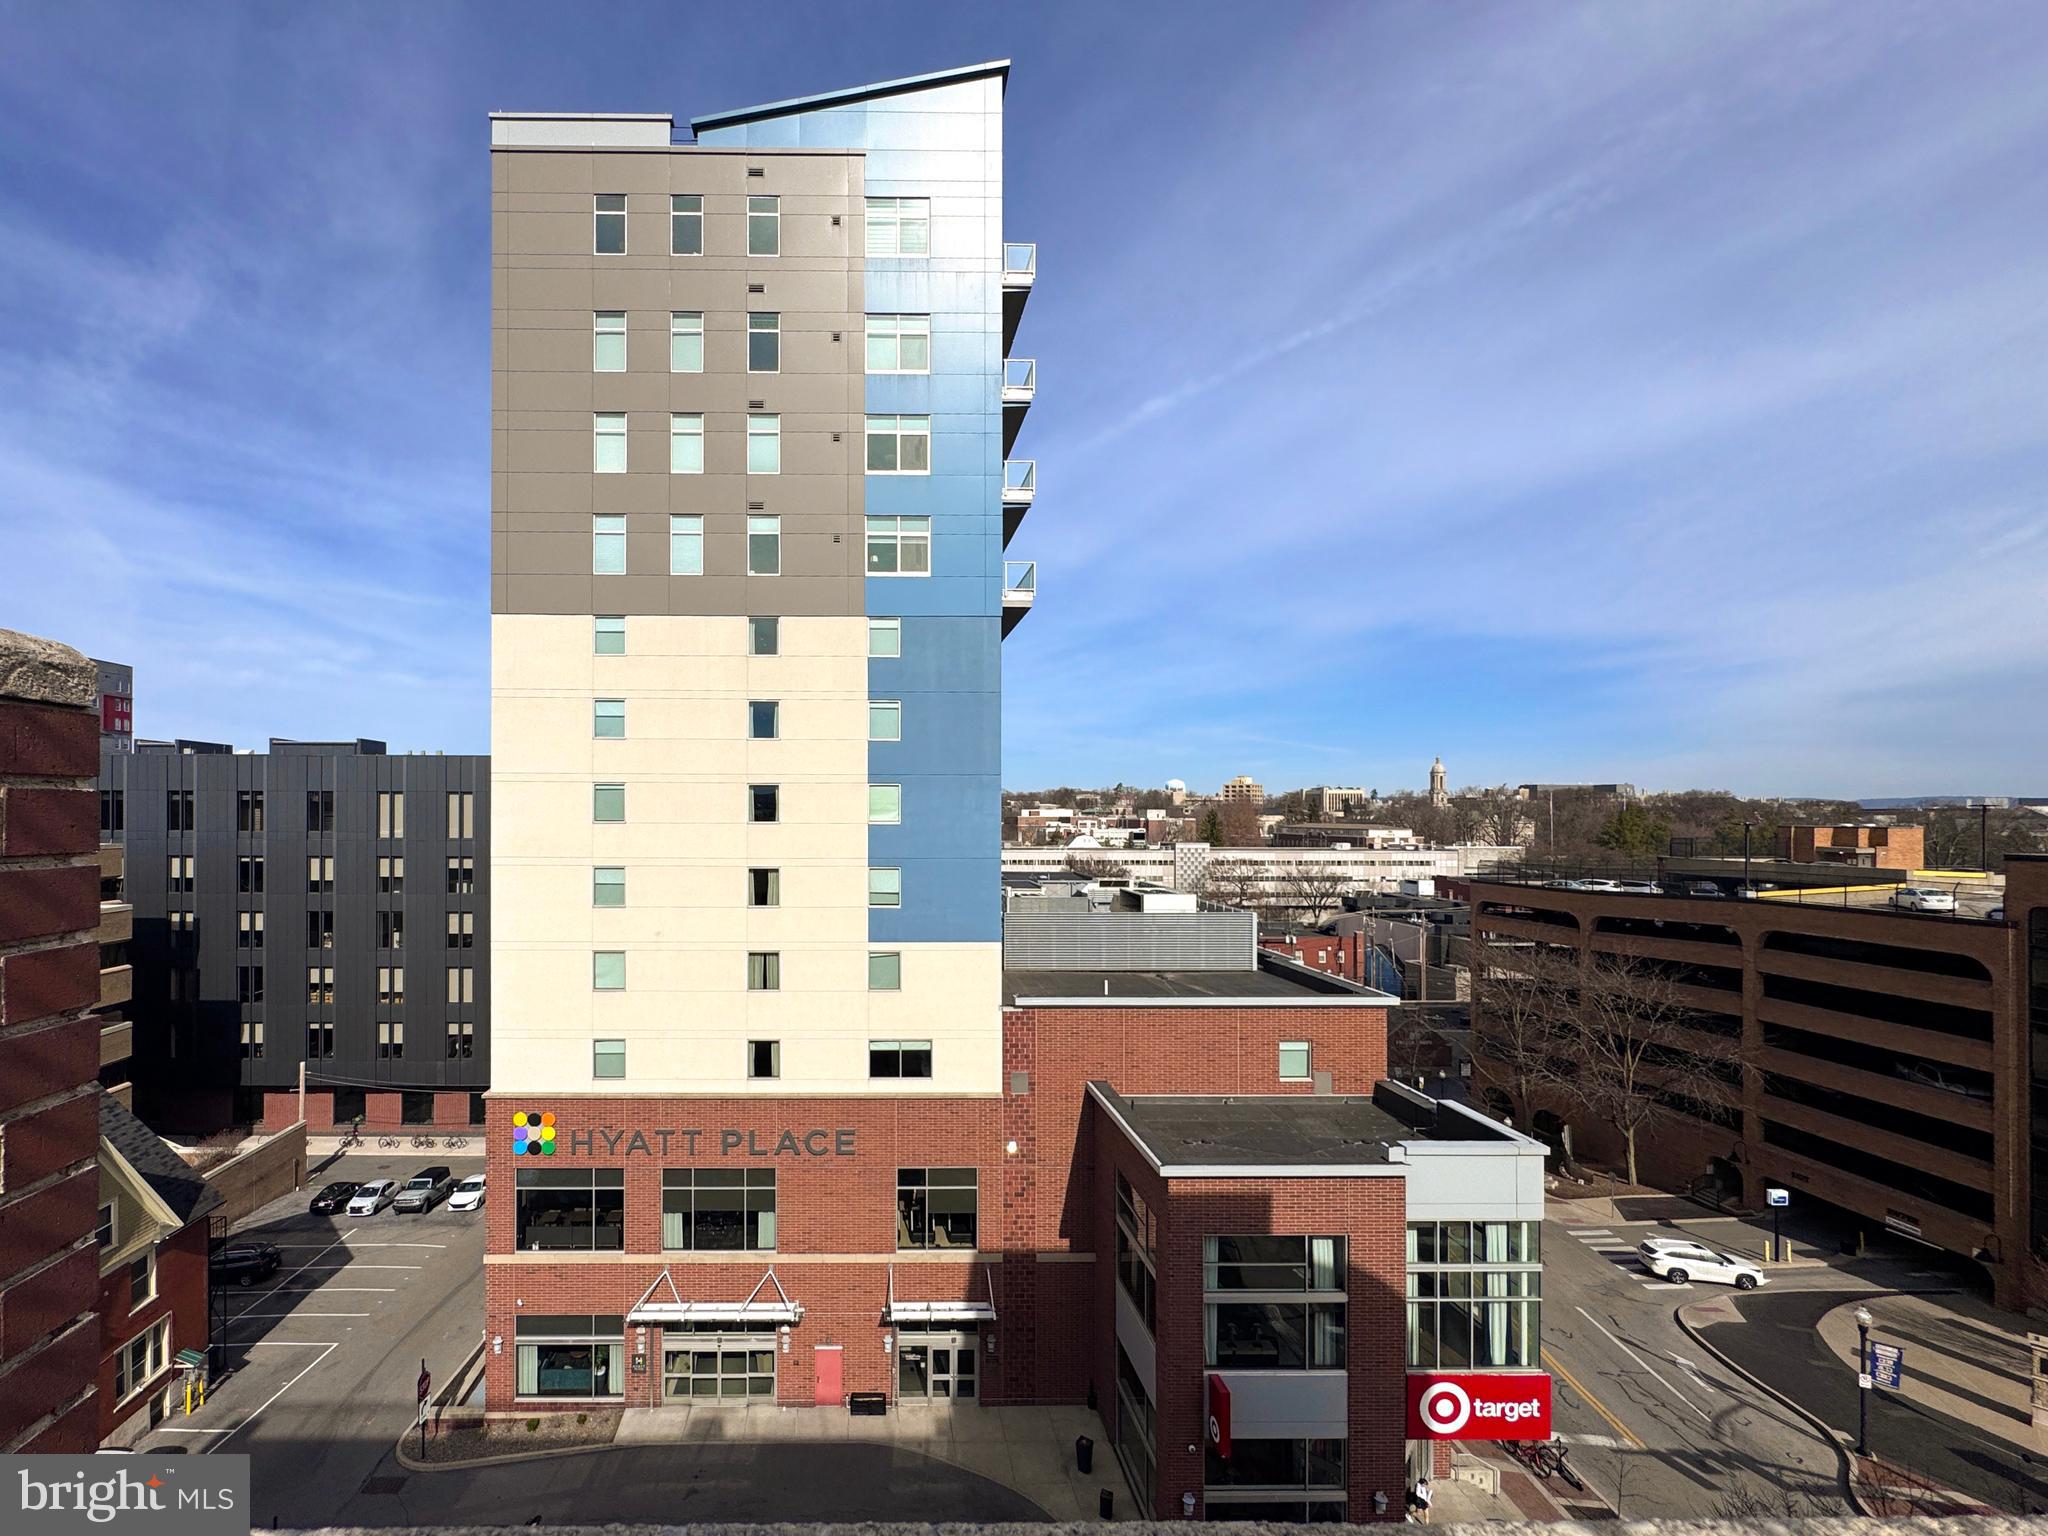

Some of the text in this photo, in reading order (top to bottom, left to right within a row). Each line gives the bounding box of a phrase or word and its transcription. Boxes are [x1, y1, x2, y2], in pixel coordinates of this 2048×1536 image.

[571, 1129, 856, 1156] HYATT PLACE
[1473, 1398, 1541, 1422] target
